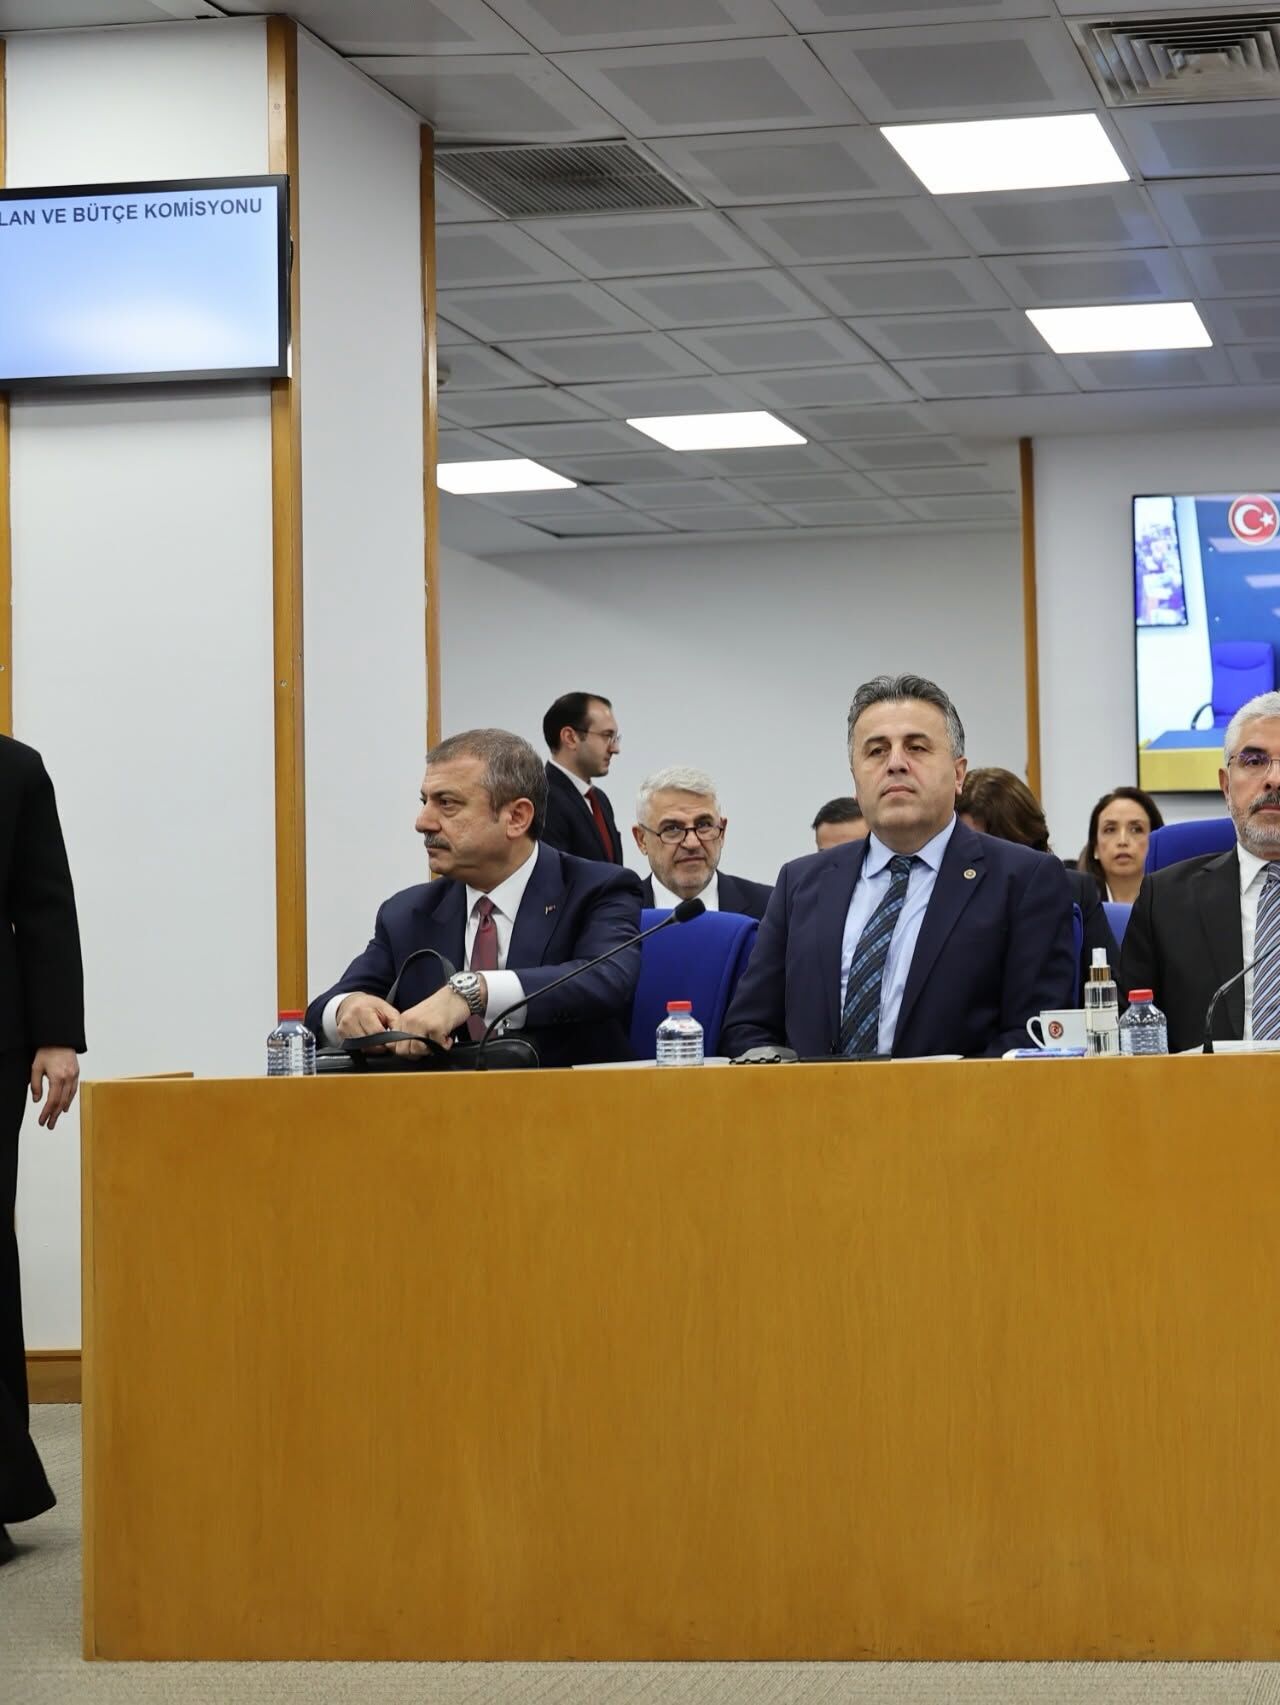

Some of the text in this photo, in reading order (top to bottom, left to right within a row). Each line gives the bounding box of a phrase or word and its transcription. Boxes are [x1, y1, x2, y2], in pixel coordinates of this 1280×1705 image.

[42, 208, 67, 224] VE
[73, 203, 138, 223] BÜTÇE
[145, 197, 262, 218] KOMİSYONU
